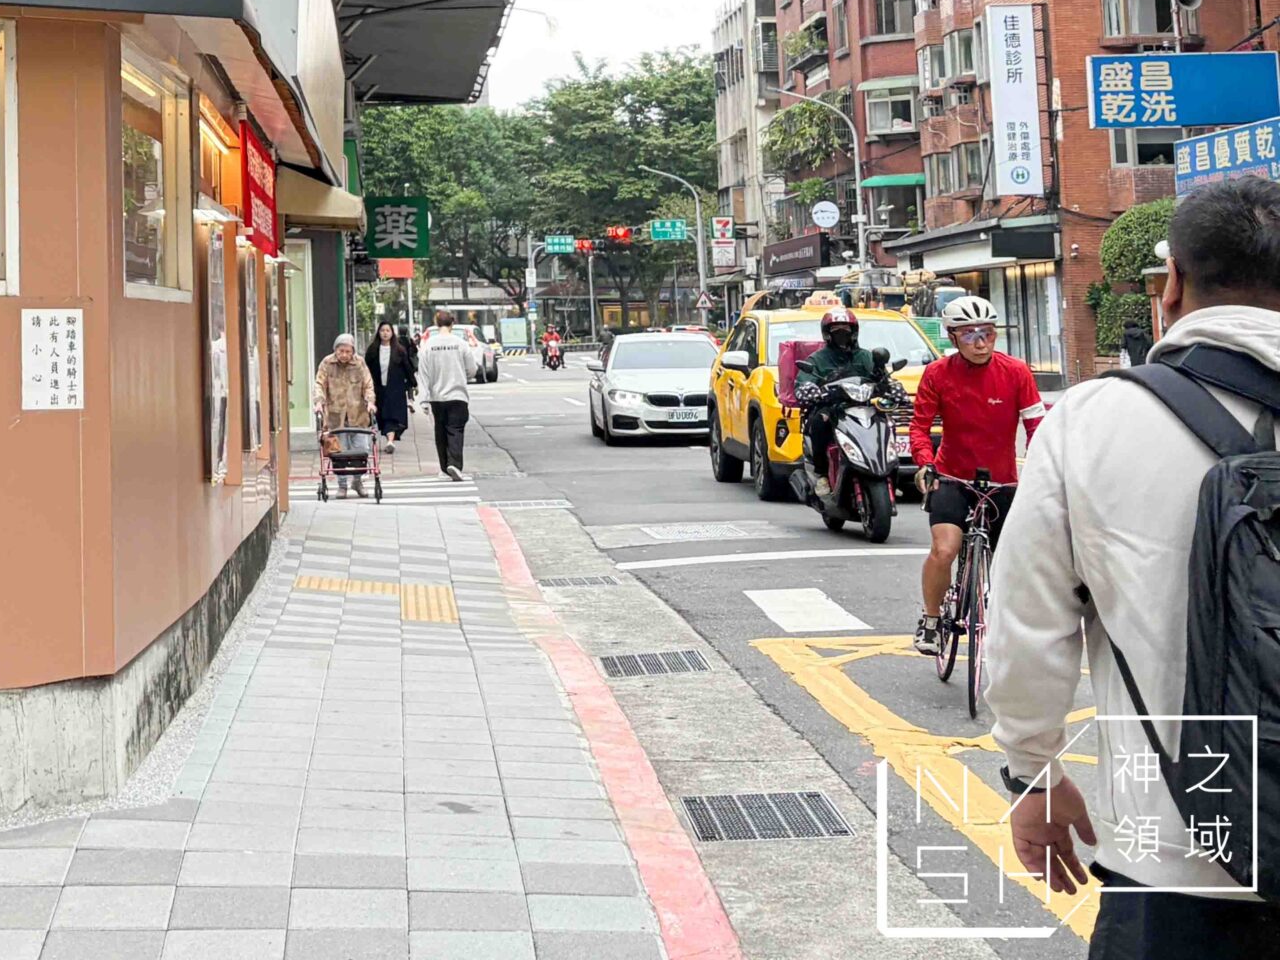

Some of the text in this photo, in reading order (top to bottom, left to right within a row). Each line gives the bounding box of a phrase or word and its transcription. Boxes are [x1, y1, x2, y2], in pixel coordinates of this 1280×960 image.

[1003, 14, 1023, 84] 佳德診所
[1099, 61, 1173, 92] 盛昌
[1100, 93, 1177, 123] 乾洗
[1177, 123, 1280, 175] 盛昌優質乾
[49, 315, 61, 406] 此有人員進出
